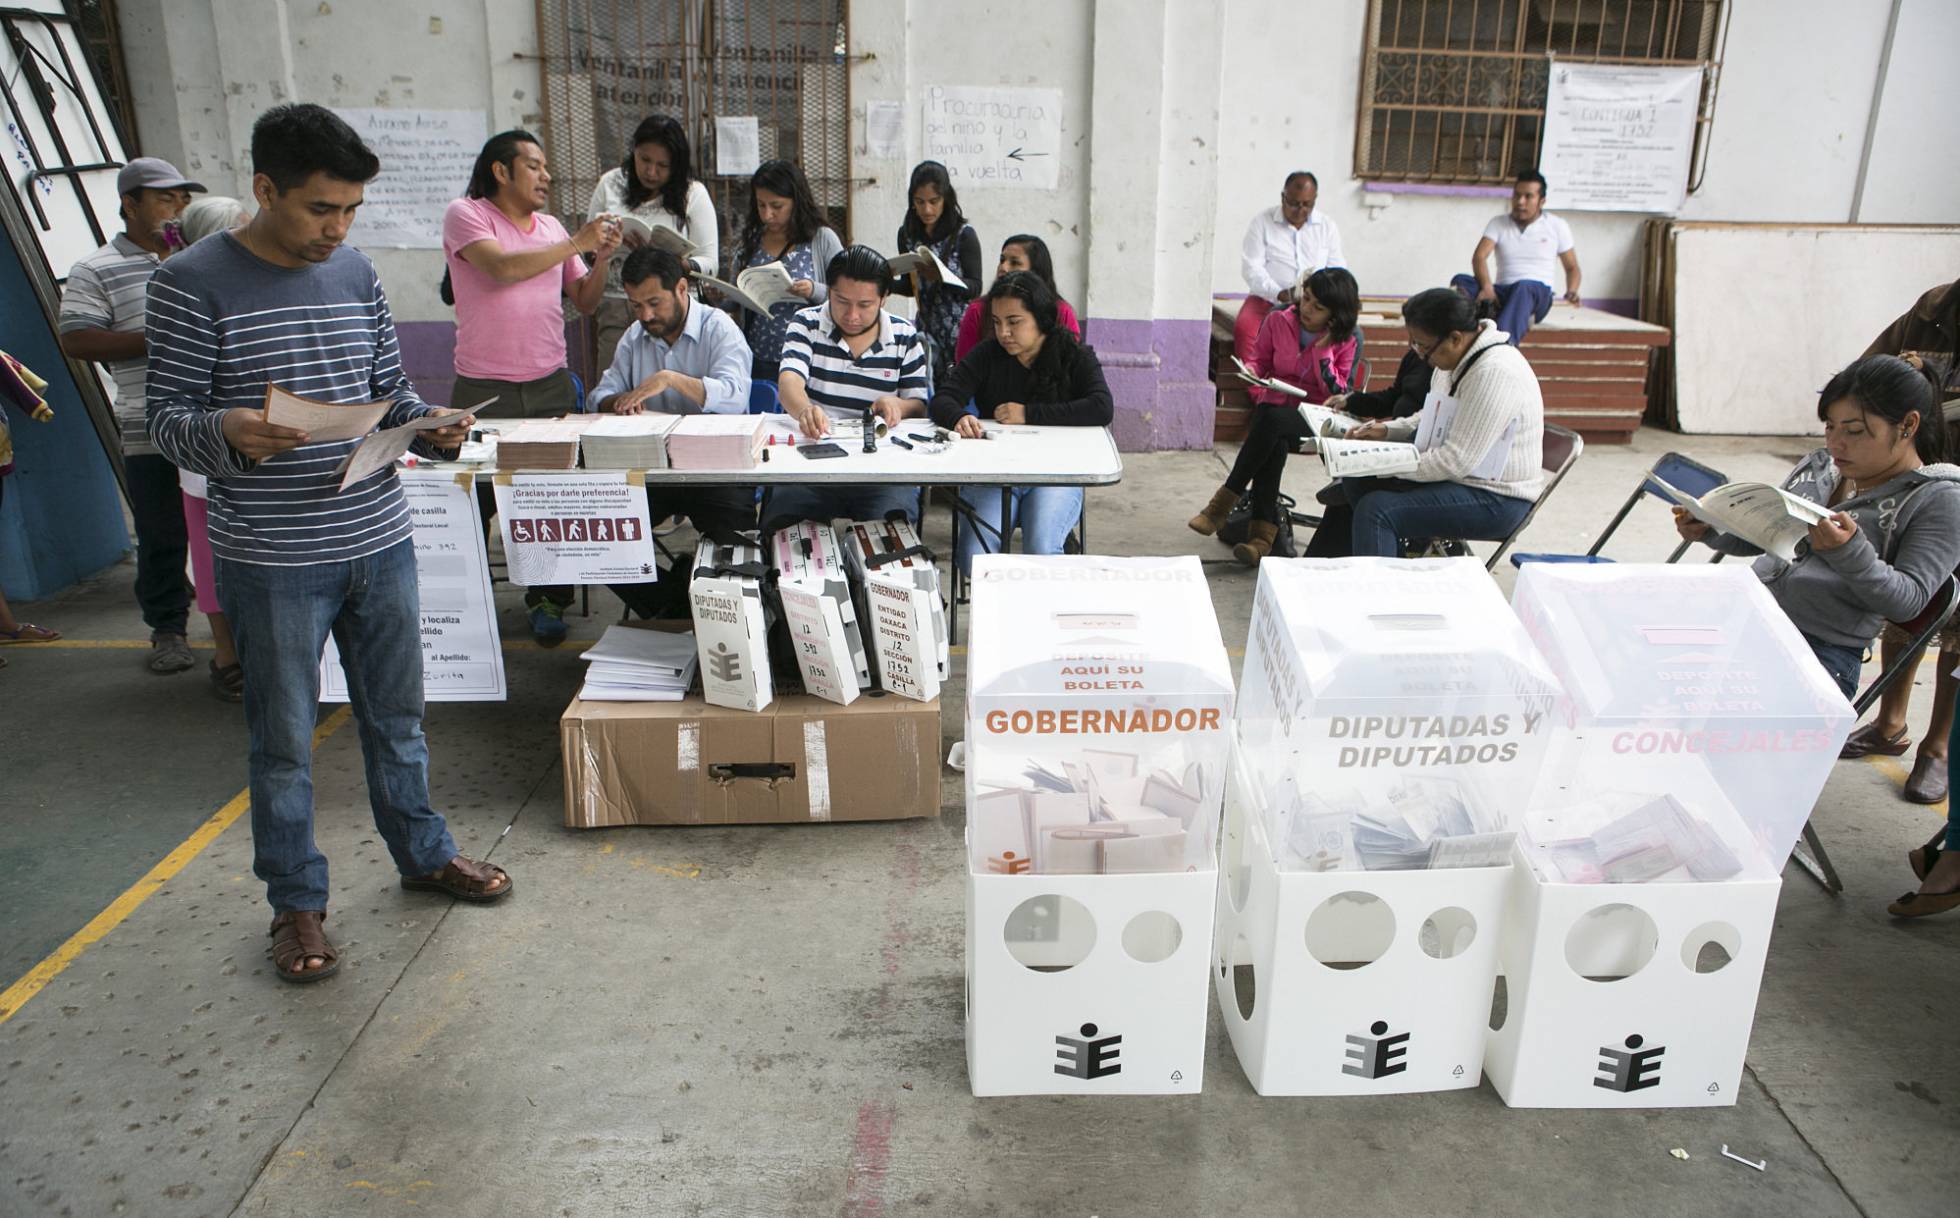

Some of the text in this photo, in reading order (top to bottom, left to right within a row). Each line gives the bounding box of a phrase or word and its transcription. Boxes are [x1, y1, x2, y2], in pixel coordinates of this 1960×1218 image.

[994, 125, 1004, 142] y
[1012, 122, 1029, 140] la
[928, 138, 984, 156] familia
[969, 159, 1024, 181] vuelta
[513, 488, 629, 498] ¡Gracias por darle preferencia!
[410, 506, 447, 515] de casilla
[870, 582, 910, 602] GOBERNADOR
[694, 594, 739, 611] DIPUTADAS Y
[699, 608, 738, 623] DIPUTADOS
[877, 604, 907, 619] ENTIDAD
[421, 615, 461, 625] y localiza
[880, 616, 908, 630] OAXACA
[803, 623, 812, 634] 12
[880, 627, 911, 642] DISTRITO
[893, 641, 903, 651] 12
[440, 654, 472, 662] Apellido:
[809, 664, 826, 677] 1752
[887, 660, 909, 674] 1752
[1118, 666, 1144, 675] SU
[887, 671, 916, 686] CASILLA
[1064, 681, 1145, 690] BOLETA
[986, 708, 1221, 735] GOBERNADOR
[1328, 712, 1542, 739] DIPUTADAS Y
[1612, 730, 1832, 755] CONCEJALES
[1338, 743, 1519, 768] DIPUTADOS
